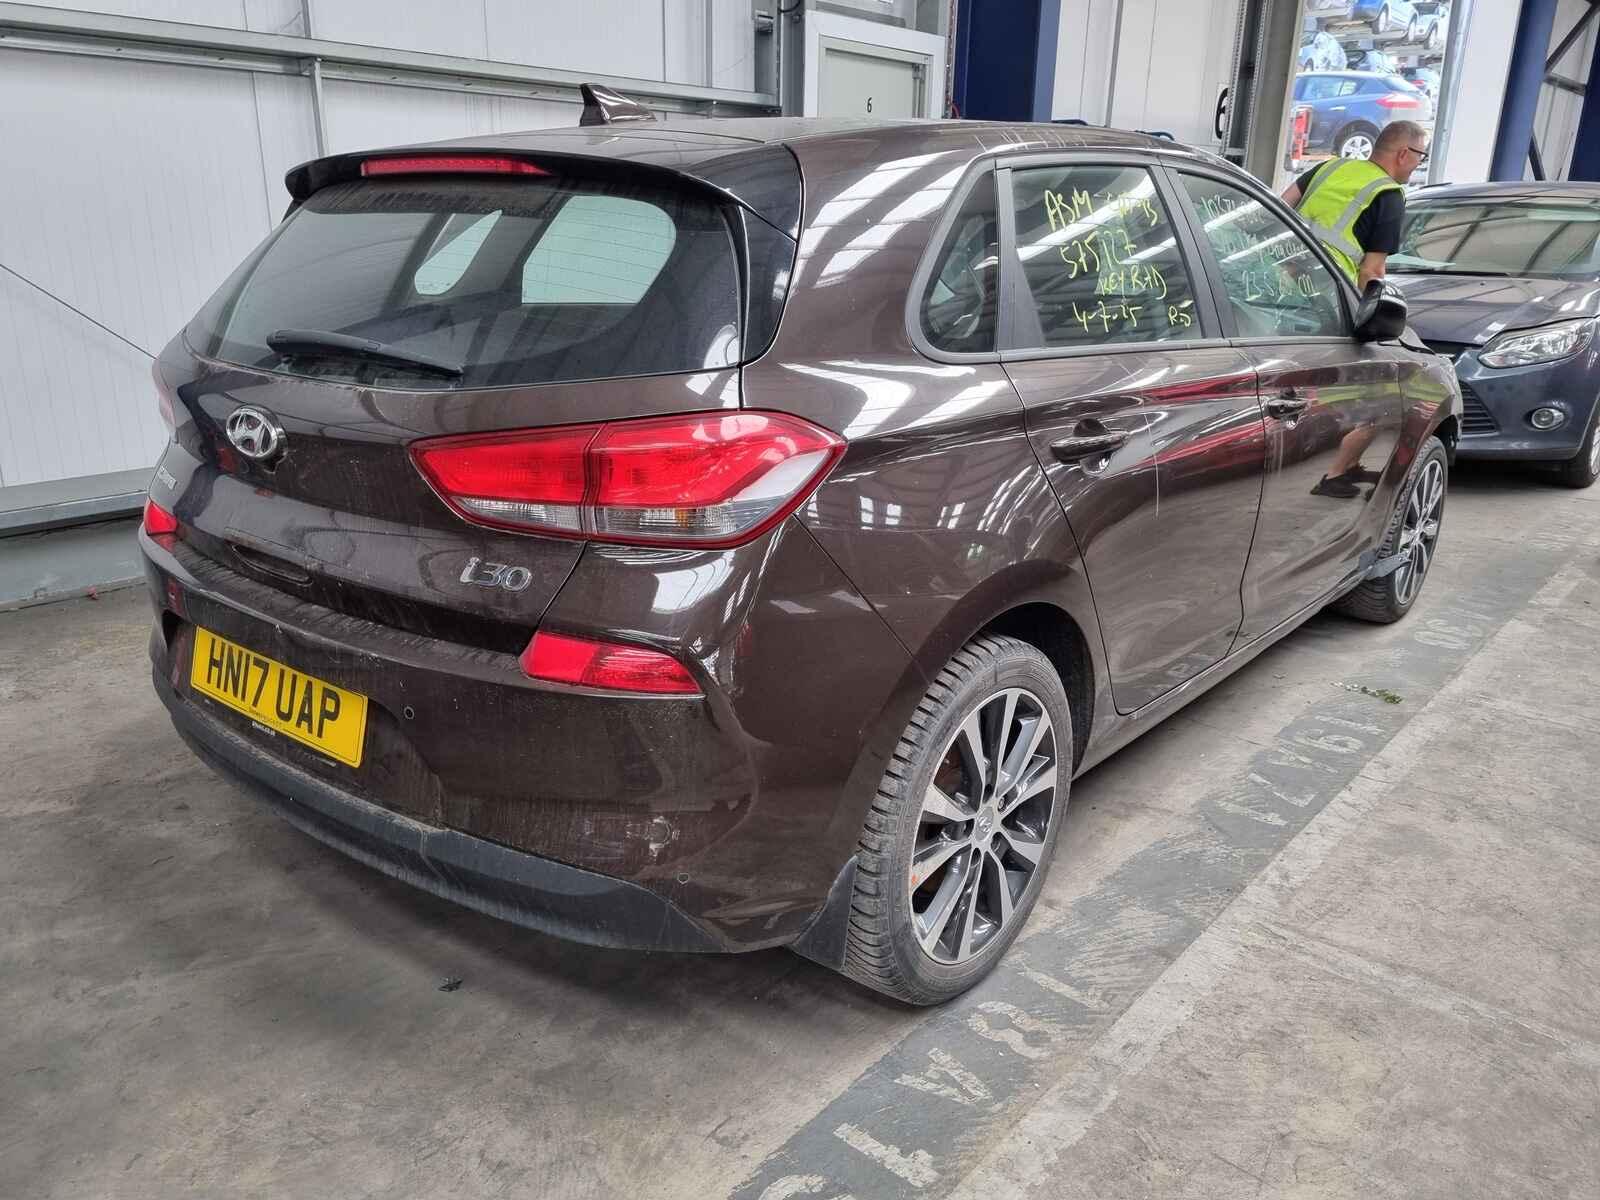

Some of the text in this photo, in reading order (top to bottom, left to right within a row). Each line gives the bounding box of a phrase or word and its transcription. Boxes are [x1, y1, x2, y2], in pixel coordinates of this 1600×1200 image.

[866, 96, 873, 113] 6
[1044, 185, 1093, 232] ASM
[460, 556, 532, 592] i30
[206, 637, 341, 739] HN17 UAP
